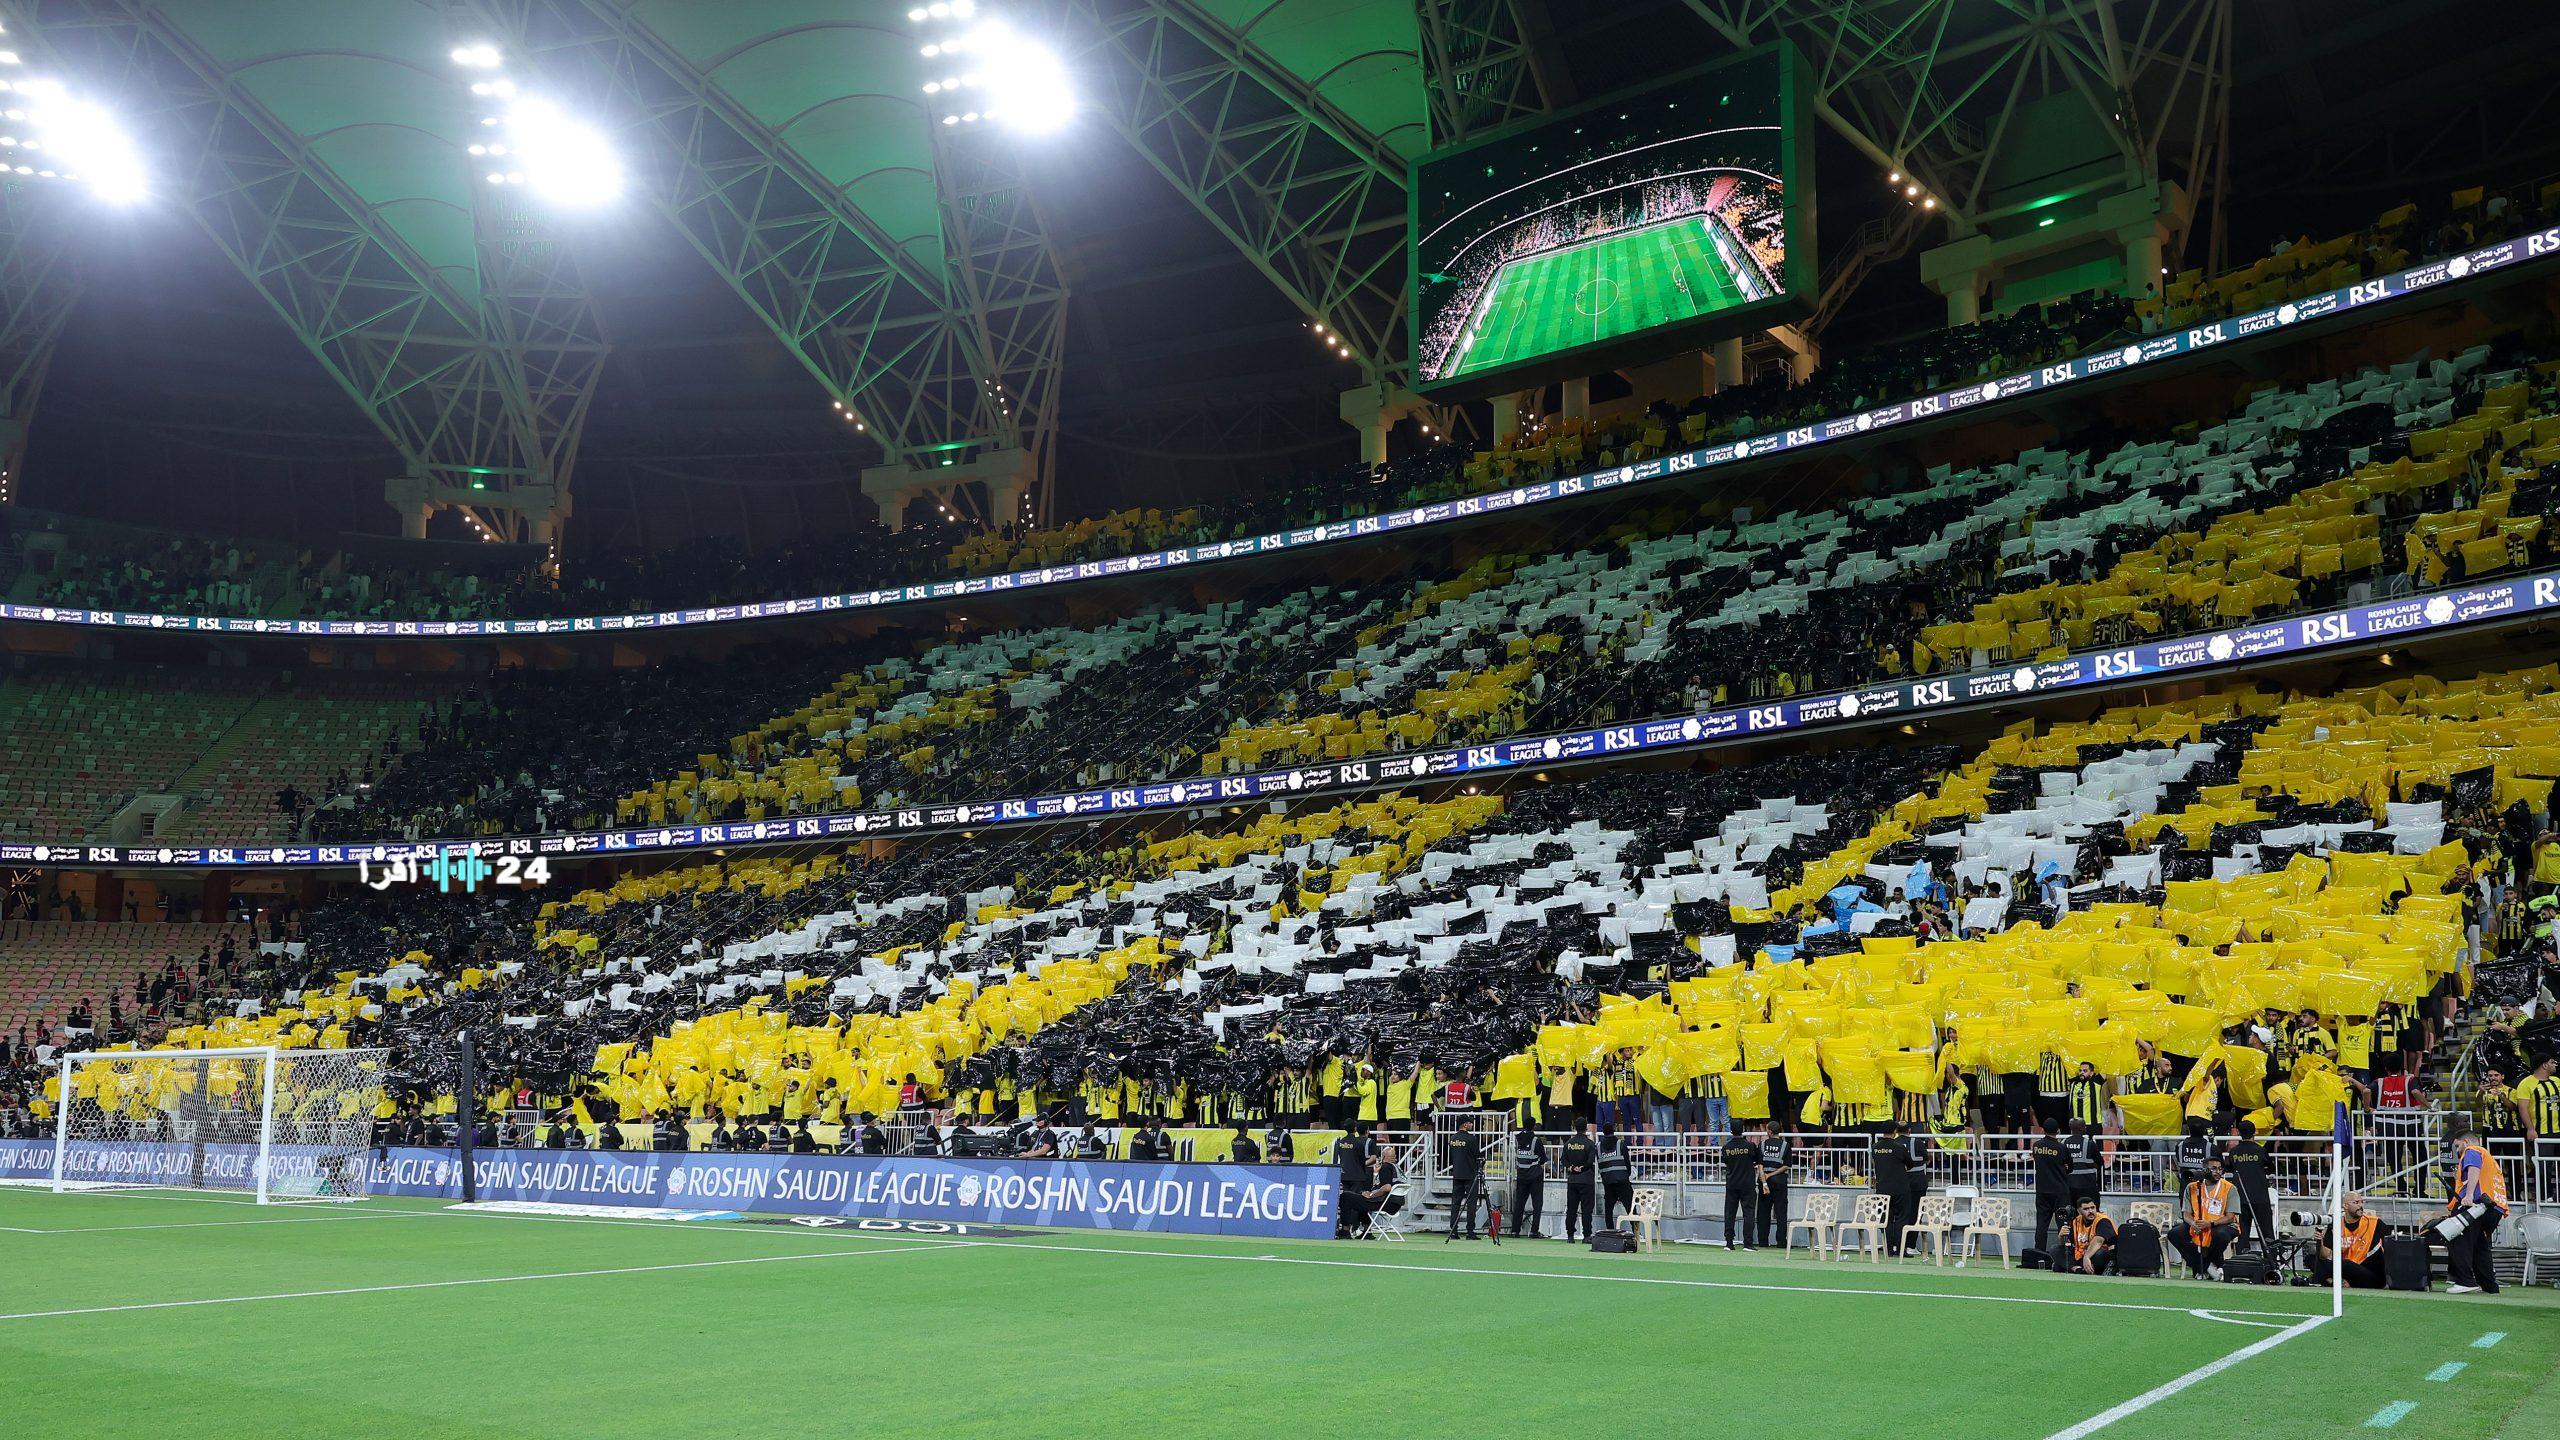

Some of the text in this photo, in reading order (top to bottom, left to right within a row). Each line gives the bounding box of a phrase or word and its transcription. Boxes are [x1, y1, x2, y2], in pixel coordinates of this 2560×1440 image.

[2528, 230, 2560, 255] RS
[2471, 245, 2512, 261] دوري روشن
[2472, 253, 2513, 272] السعودي
[2404, 264, 2445, 278] ROSHN SAUDI
[2405, 271, 2445, 289] LEAGUE
[2350, 280, 2391, 305] RSL
[2239, 317, 2275, 333] LEAGUE
[2189, 324, 2226, 348] RSL
[2088, 358, 2121, 372] LEAGUE
[2043, 363, 2076, 385] RSL
[1912, 397, 1943, 417] RSL
[1950, 393, 1980, 407] LEAGUE
[1787, 427, 1816, 446] RSL
[1826, 424, 1854, 436] LEAGUE
[1670, 454, 1697, 472] RSL
[1559, 478, 1585, 495] RSL
[1457, 499, 1482, 514] RSL
[1357, 518, 1380, 533] RSL
[1261, 535, 1283, 549] RSL
[1168, 550, 1190, 564] RSL
[1080, 563, 1101, 577] RSL
[992, 575, 1013, 589] RSL
[907, 586, 927, 599] RSL
[2457, 588, 2512, 604] دوري روشن
[822, 596, 842, 609] RSL
[2458, 598, 2513, 620] السعودي
[90, 612, 116, 624] RSL
[660, 613, 679, 624] RSL
[742, 605, 762, 617] RSL
[2367, 604, 2421, 618] ROSHN SAUDI
[197, 618, 222, 629] RSL
[299, 622, 322, 633] RSL
[395, 623, 418, 634] RSL
[486, 622, 507, 633] RSL
[575, 618, 595, 630] RSL
[2302, 614, 2356, 644] RSL
[2368, 613, 2421, 632] LEAGUE
[2236, 628, 2284, 642] دوري روشن
[2158, 641, 2205, 653] ROSHN SAUDI
[2237, 637, 2284, 657] السعودي
[2095, 651, 2142, 678] RSL
[2159, 649, 2205, 666] LEAGUE
[2037, 662, 2079, 675] دوري روشن
[1991, 673, 2010, 681] SAUDI
[2038, 670, 2080, 688] السعودي
[1913, 681, 1955, 706] RSL
[1969, 681, 2010, 696] LEAGUE
[1749, 707, 1787, 729] RSL
[1800, 707, 1836, 721] LEAGUE
[1605, 728, 1639, 749] RSL
[1646, 730, 1680, 743] LEAGUE
[1468, 747, 1499, 767] RSL
[1510, 749, 1542, 760] LEAGUE
[1341, 762, 1370, 782] RSL
[1381, 766, 1409, 777] LEAGUE
[1222, 778, 1249, 796] RSL
[1259, 781, 1286, 791] LEAGUE
[1112, 790, 1138, 807] RSL
[1003, 801, 1028, 818] RSL
[899, 811, 923, 827] RSL
[702, 827, 725, 842] RSL
[797, 820, 821, 835] RSL
[510, 840, 533, 854] RSL
[606, 834, 628, 848] RSL
[89, 848, 119, 861] RSL
[209, 849, 236, 862] RSL
[319, 848, 343, 861] RSL
[416, 845, 439, 858] RSL
[1725, 1147, 1749, 1156] Police
[2033, 1146, 2058, 1156] Police
[2233, 1153, 2259, 1162] Police
[18, 1149, 54, 1170] SAUDI
[107, 1151, 248, 1178] ROSHN SAUDI EAGUE
[267, 1155, 318, 1179] ROSHN
[518, 1161, 581, 1191] SAUDI
[580, 1164, 660, 1195] LEAGUE
[687, 1166, 954, 1206] ROSHN SAUDI LEAGUE
[984, 1174, 1331, 1223] ROSHN SAUDI LEAGUE
